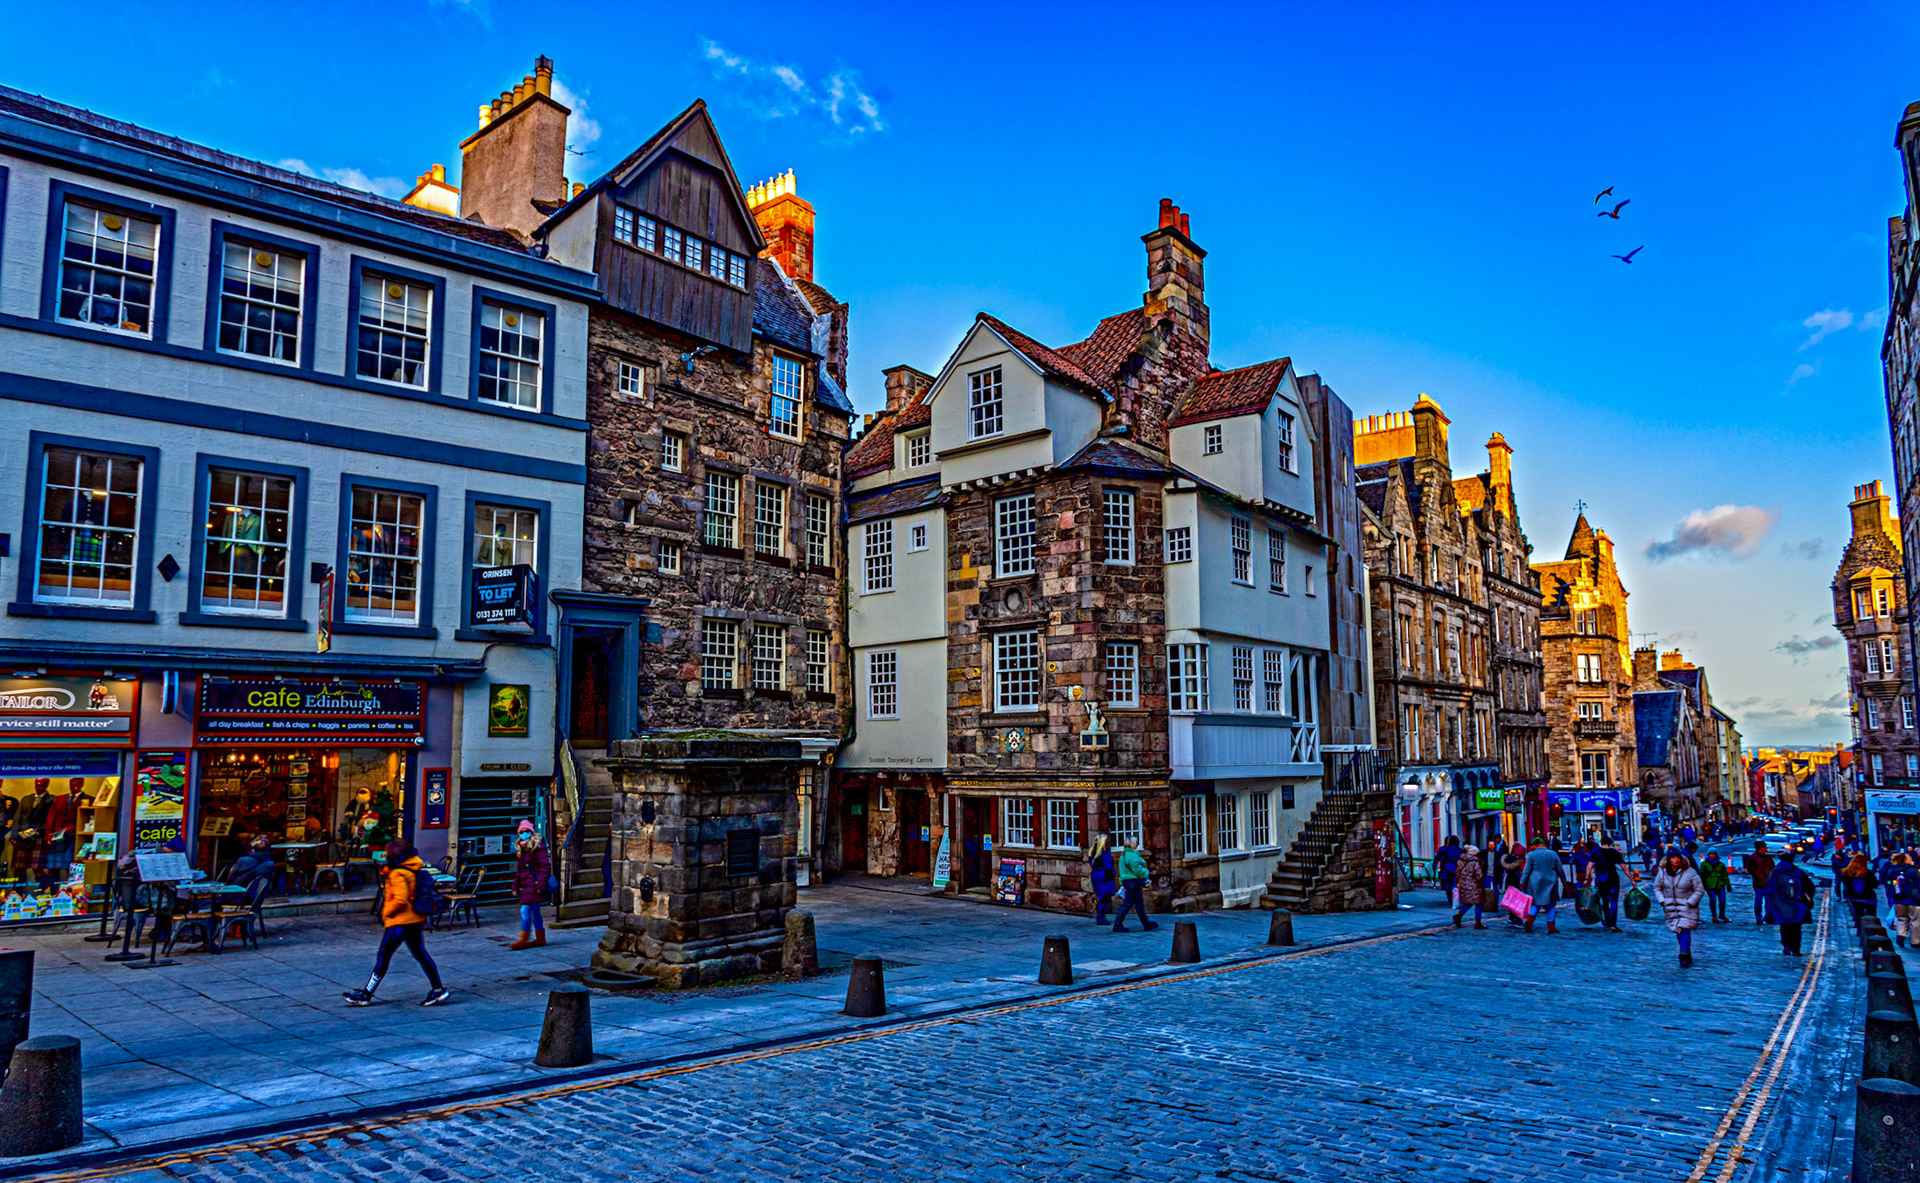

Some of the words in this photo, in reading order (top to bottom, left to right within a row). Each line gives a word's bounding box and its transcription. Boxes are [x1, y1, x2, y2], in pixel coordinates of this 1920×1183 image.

[482, 569, 513, 578] ORINSEN
[479, 589, 493, 600] TO
[495, 588, 514, 599] LET
[492, 609, 503, 617] 374
[504, 608, 516, 616] 1111
[0, 696, 57, 709] TAILOR
[248, 687, 300, 707] cafe
[305, 694, 381, 712] Edinburgh
[0, 720, 33, 728] rvice
[35, 720, 60, 728] still
[218, 721, 232, 730] day
[292, 722, 310, 730] chips
[318, 722, 340, 730] haggis
[348, 722, 370, 730] paninis
[1480, 789, 1501, 798] wbf
[1878, 799, 1915, 809] ragamuffin
[140, 826, 176, 840] cafe
